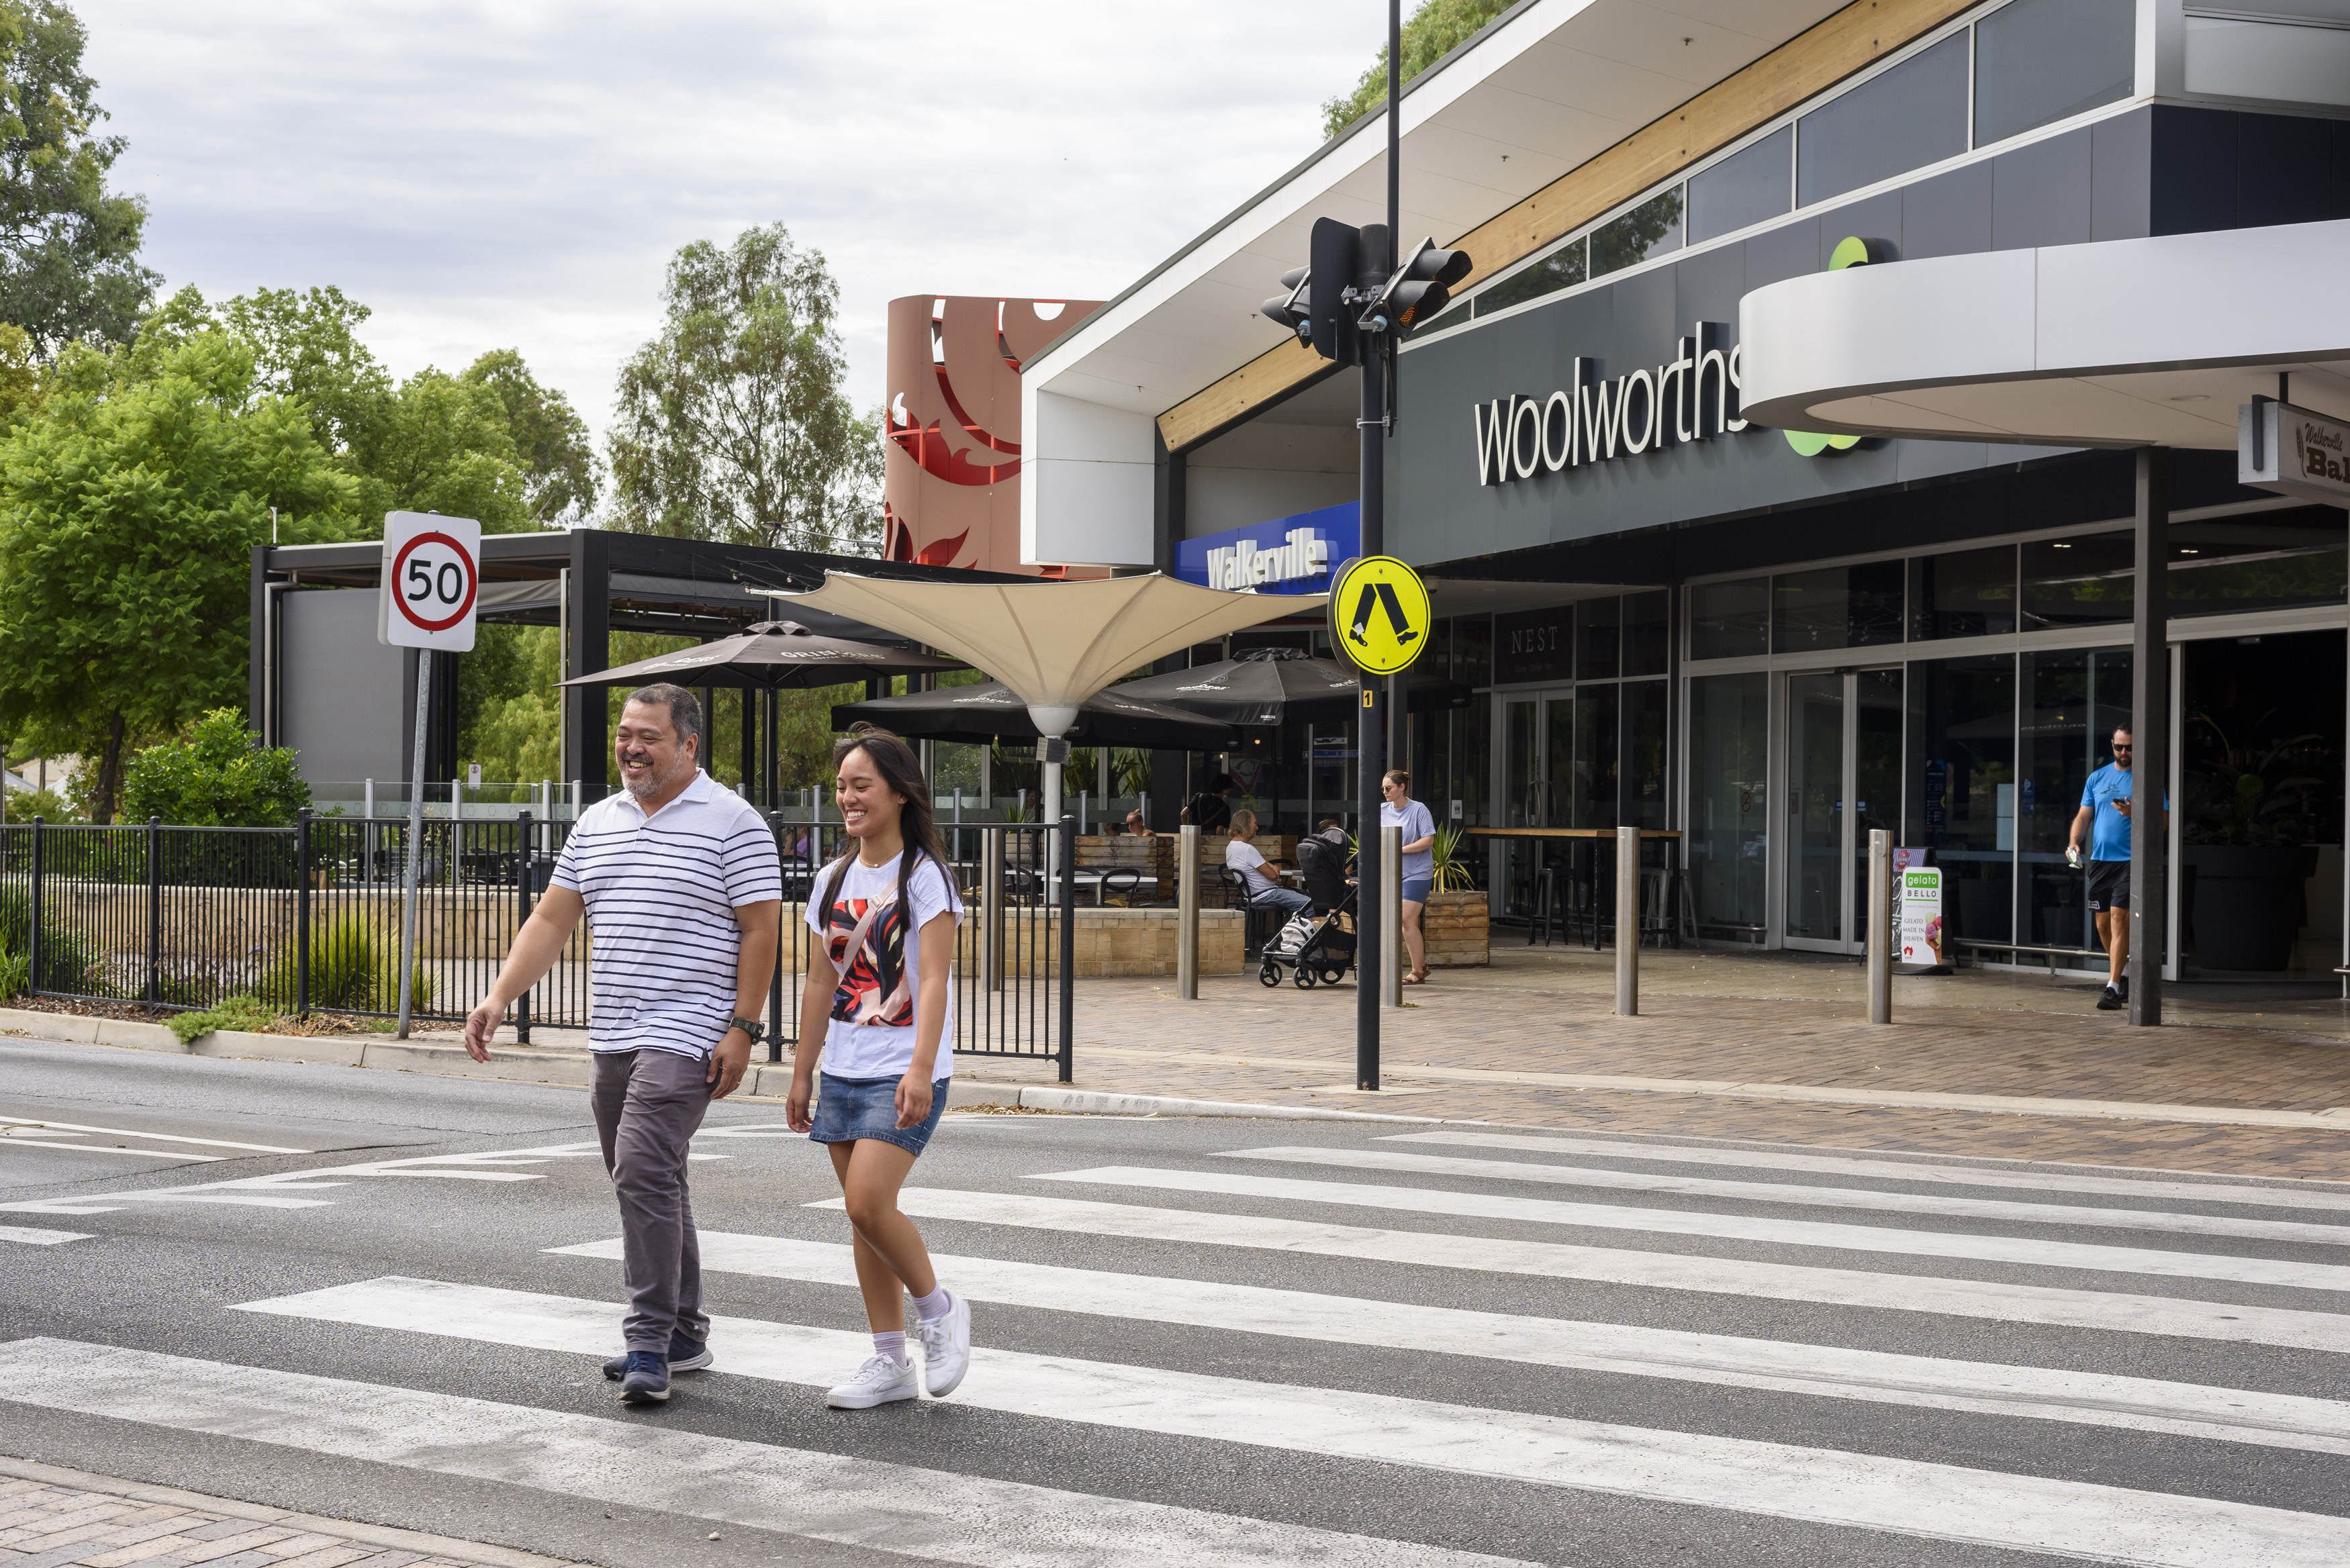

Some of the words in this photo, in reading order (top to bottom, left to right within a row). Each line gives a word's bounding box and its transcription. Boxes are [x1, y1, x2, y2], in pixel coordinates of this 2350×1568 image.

[2305, 422, 2343, 452] Walkerville
[1207, 527, 1328, 591] Walkerville
[407, 558, 463, 605] 50
[1511, 626, 1558, 654] NEST
[1364, 692, 1370, 706] 1
[1908, 875, 1937, 886] gelato
[1908, 889, 1937, 897] BELLO
